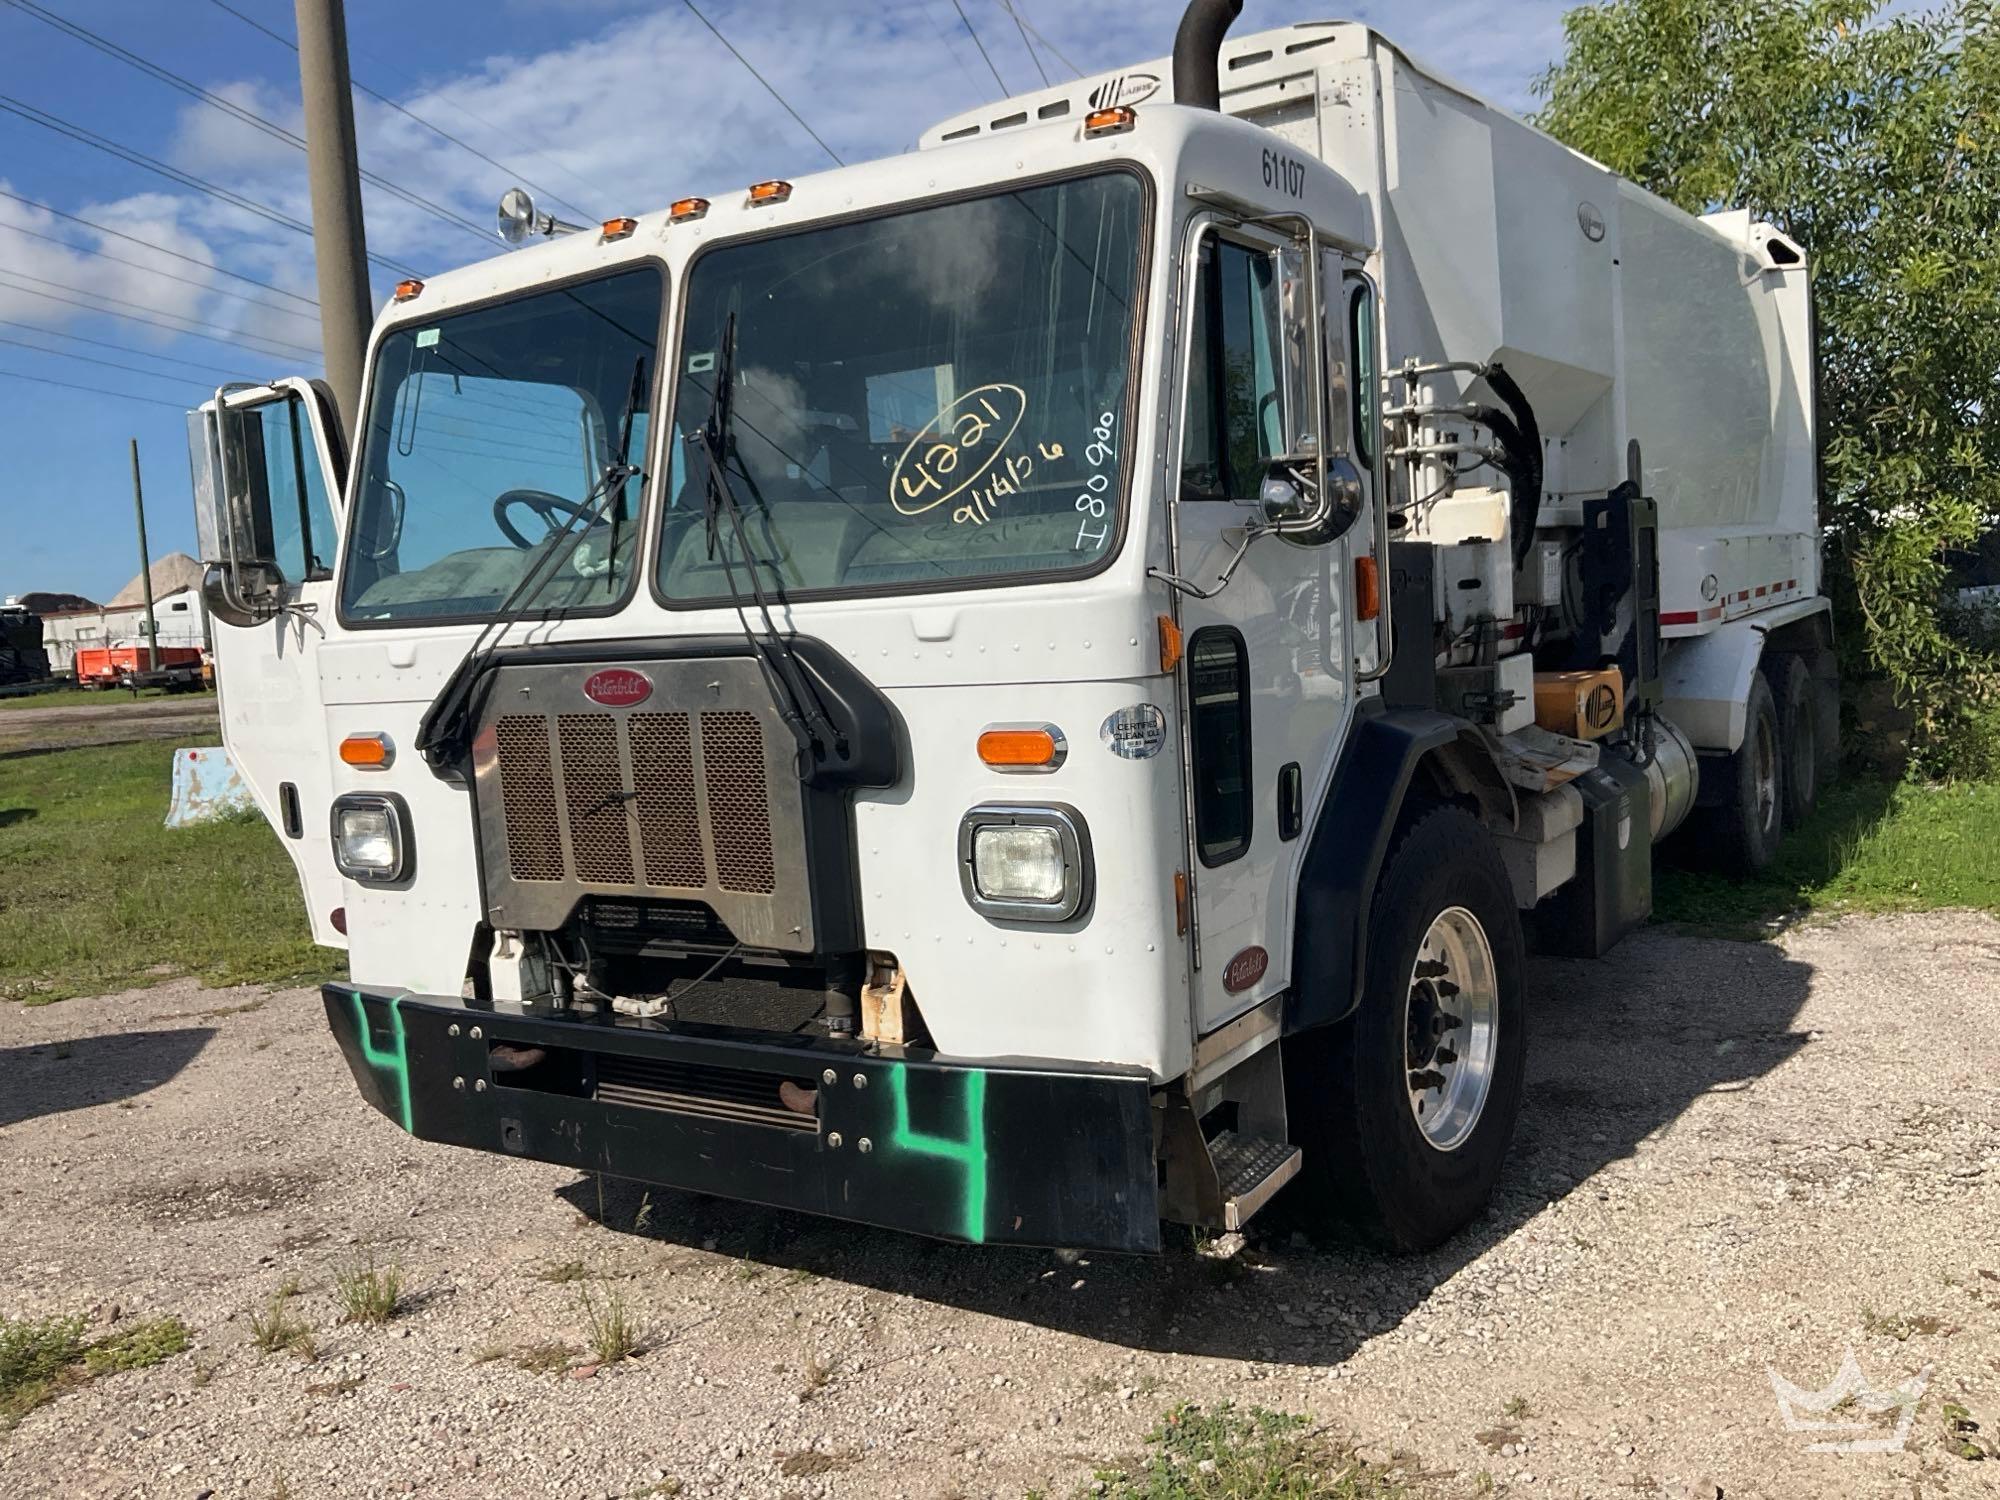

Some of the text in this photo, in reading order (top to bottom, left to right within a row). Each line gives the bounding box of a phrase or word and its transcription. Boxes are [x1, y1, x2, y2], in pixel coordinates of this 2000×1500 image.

[1262, 148, 1305, 199] 61107
[901, 398, 1000, 497] 4221
[590, 675, 645, 698] Peterbilt
[1231, 952, 1265, 987] Peterbilt
[351, 991, 413, 1134] 4
[890, 1061, 988, 1243] 4
